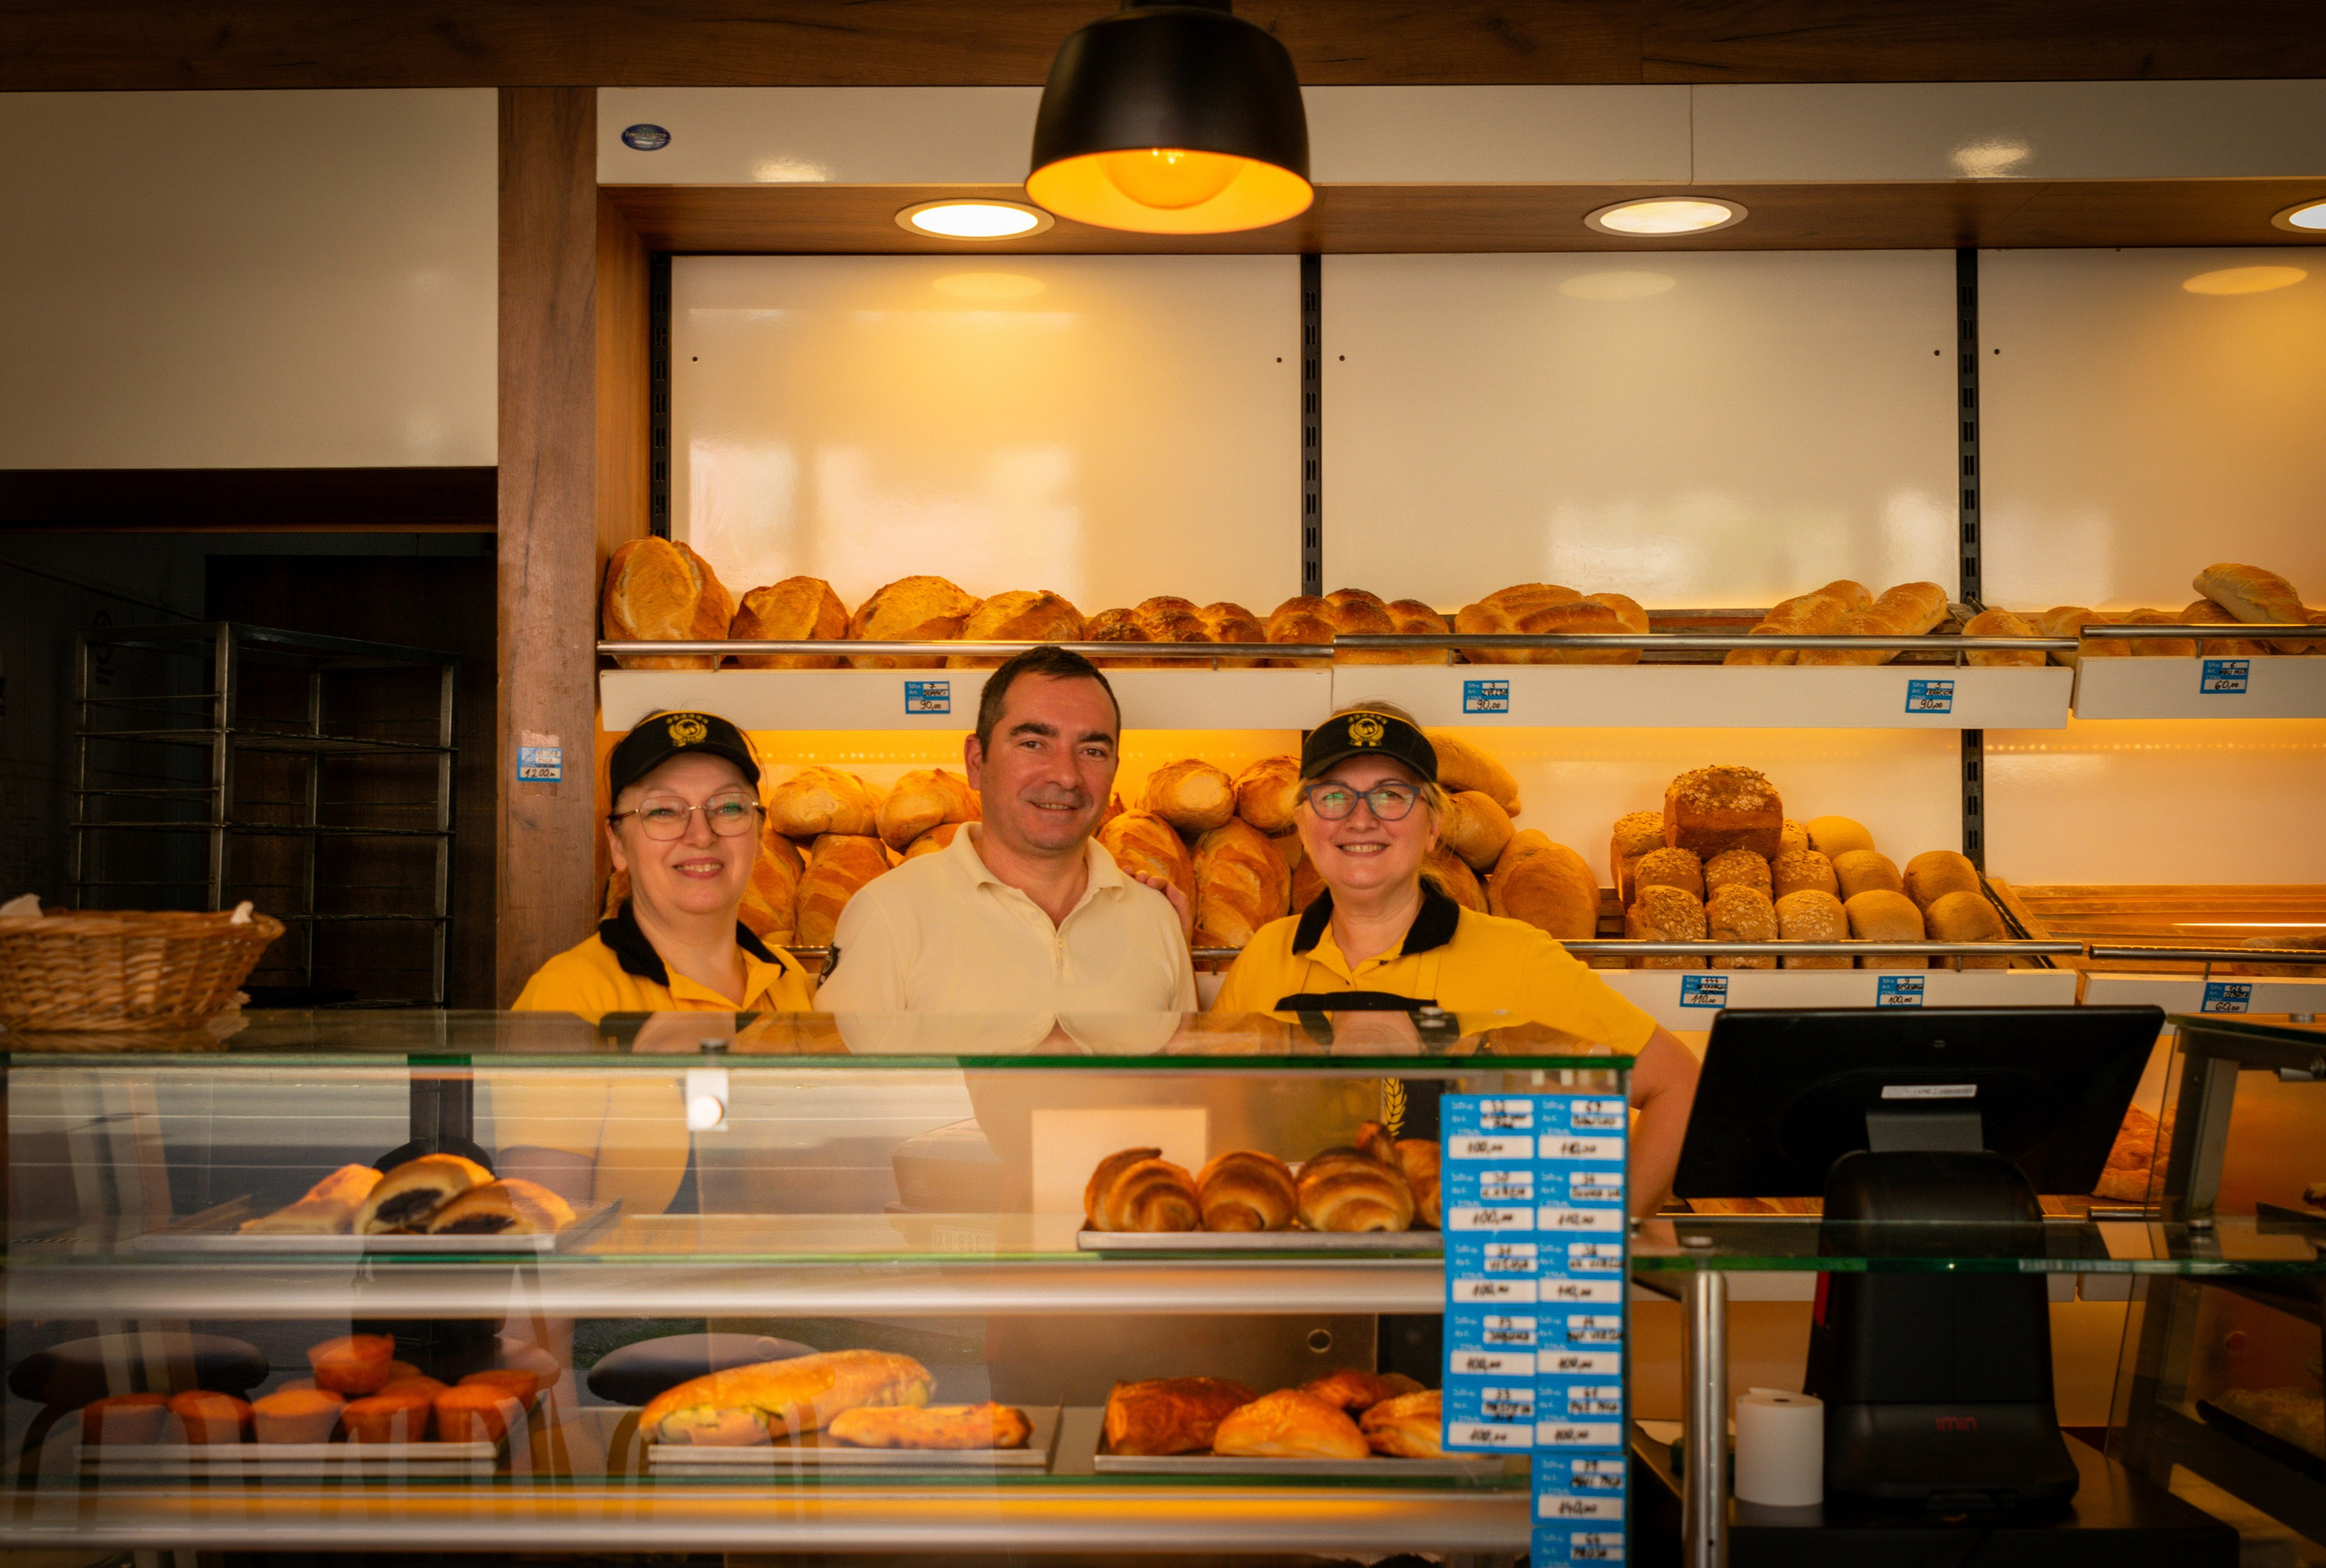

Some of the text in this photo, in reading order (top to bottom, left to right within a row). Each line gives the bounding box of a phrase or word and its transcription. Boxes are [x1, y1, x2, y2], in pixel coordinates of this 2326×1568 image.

[919, 700, 941, 711] 90,00
[1476, 700, 1500, 710] 90,00
[1919, 700, 1943, 710] 90,00
[1904, 977, 1910, 985] 9
[1691, 995, 1715, 1004] 110,00
[1888, 996, 1913, 1005] 100,00
